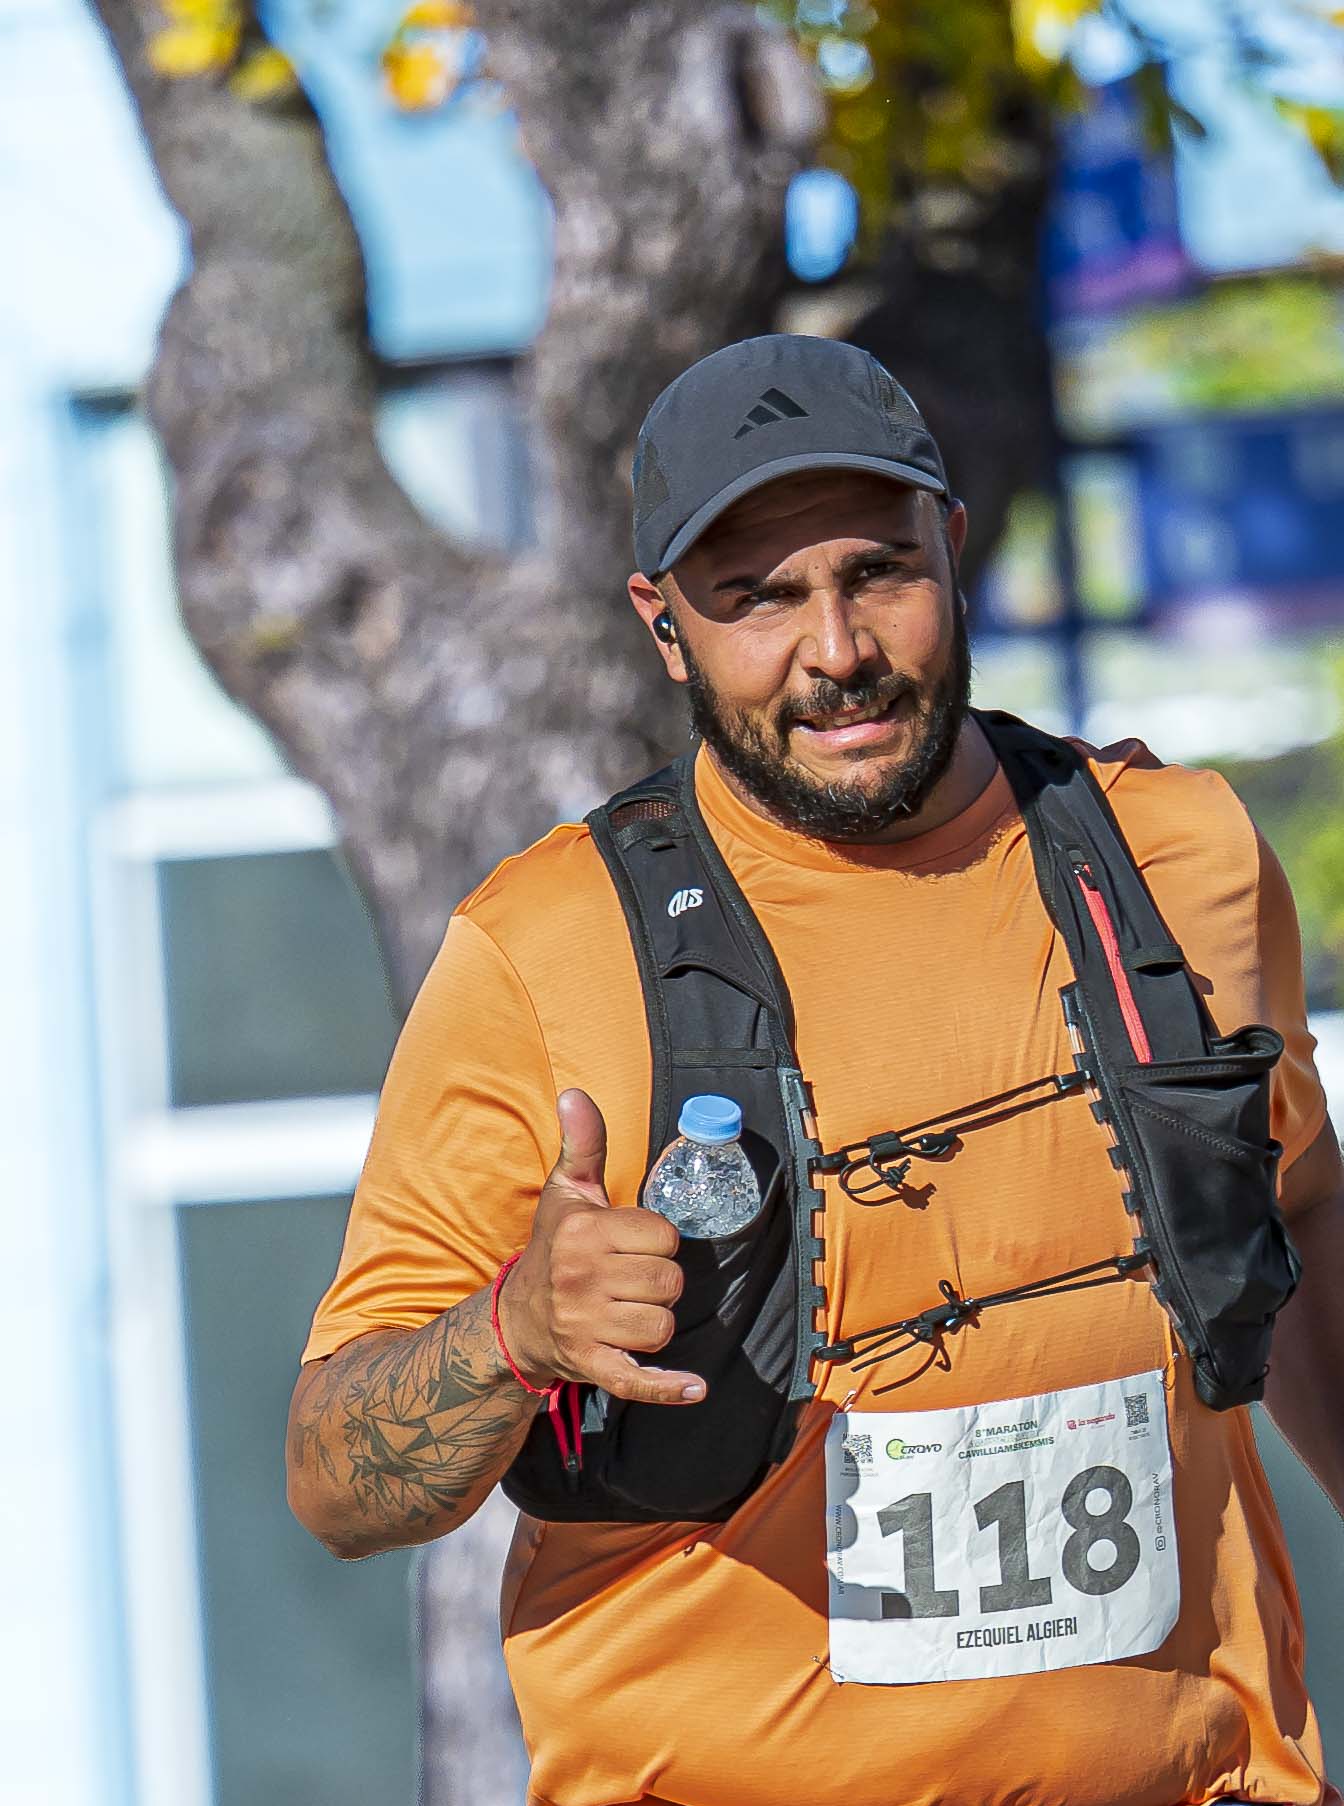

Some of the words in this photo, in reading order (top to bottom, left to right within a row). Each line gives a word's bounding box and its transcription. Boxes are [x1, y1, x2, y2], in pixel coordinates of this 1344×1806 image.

[876, 1465, 1141, 1619] 118
[957, 1626, 1023, 1648] EZEQUIEL
[1027, 1617, 1077, 1642] ALGIERI
